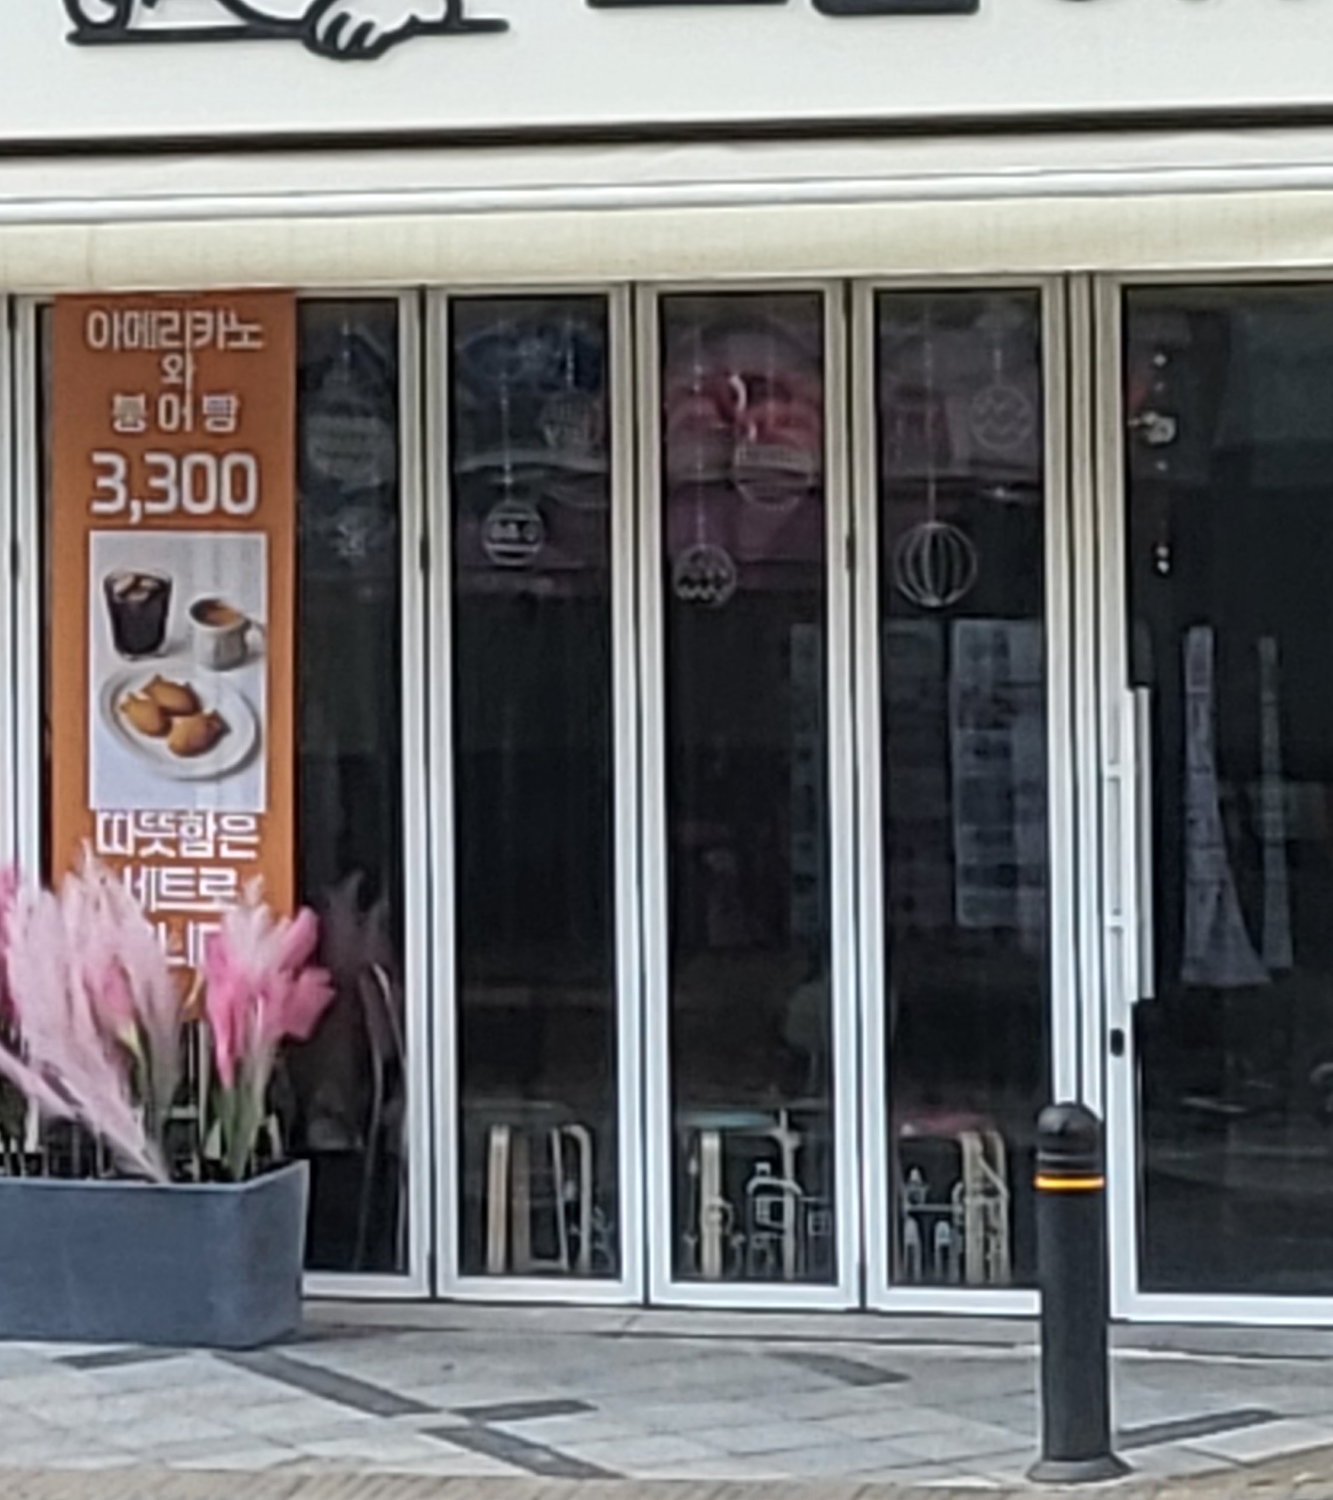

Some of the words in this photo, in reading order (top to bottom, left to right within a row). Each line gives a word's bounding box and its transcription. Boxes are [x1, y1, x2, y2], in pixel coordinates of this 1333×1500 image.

[86, 309, 265, 350] 아메리카노
[160, 352, 196, 391] 와
[89, 450, 259, 524] 3,300
[95, 808, 261, 859] 따뜻함은
